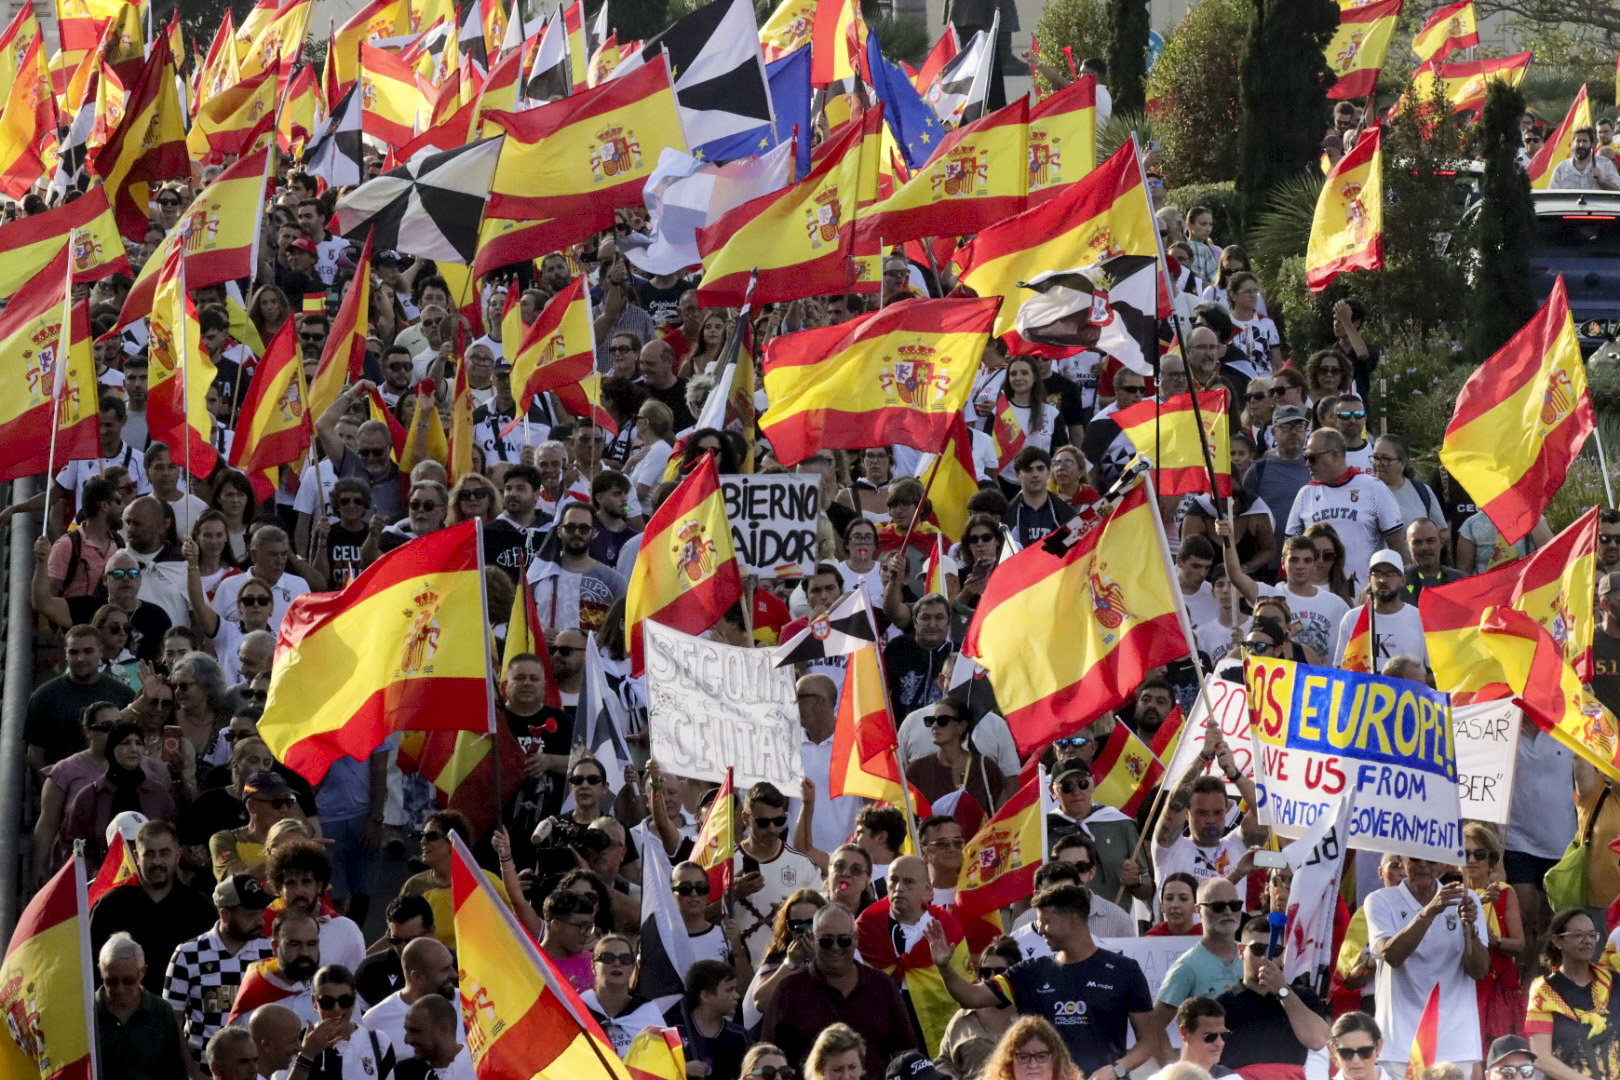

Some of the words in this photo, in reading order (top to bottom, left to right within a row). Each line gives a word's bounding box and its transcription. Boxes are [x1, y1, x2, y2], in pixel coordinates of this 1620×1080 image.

[1311, 507, 1358, 523] CEUTA
[668, 710, 790, 784] CEUTA
[1304, 757, 1347, 795] US
[1356, 764, 1427, 802] FROM
